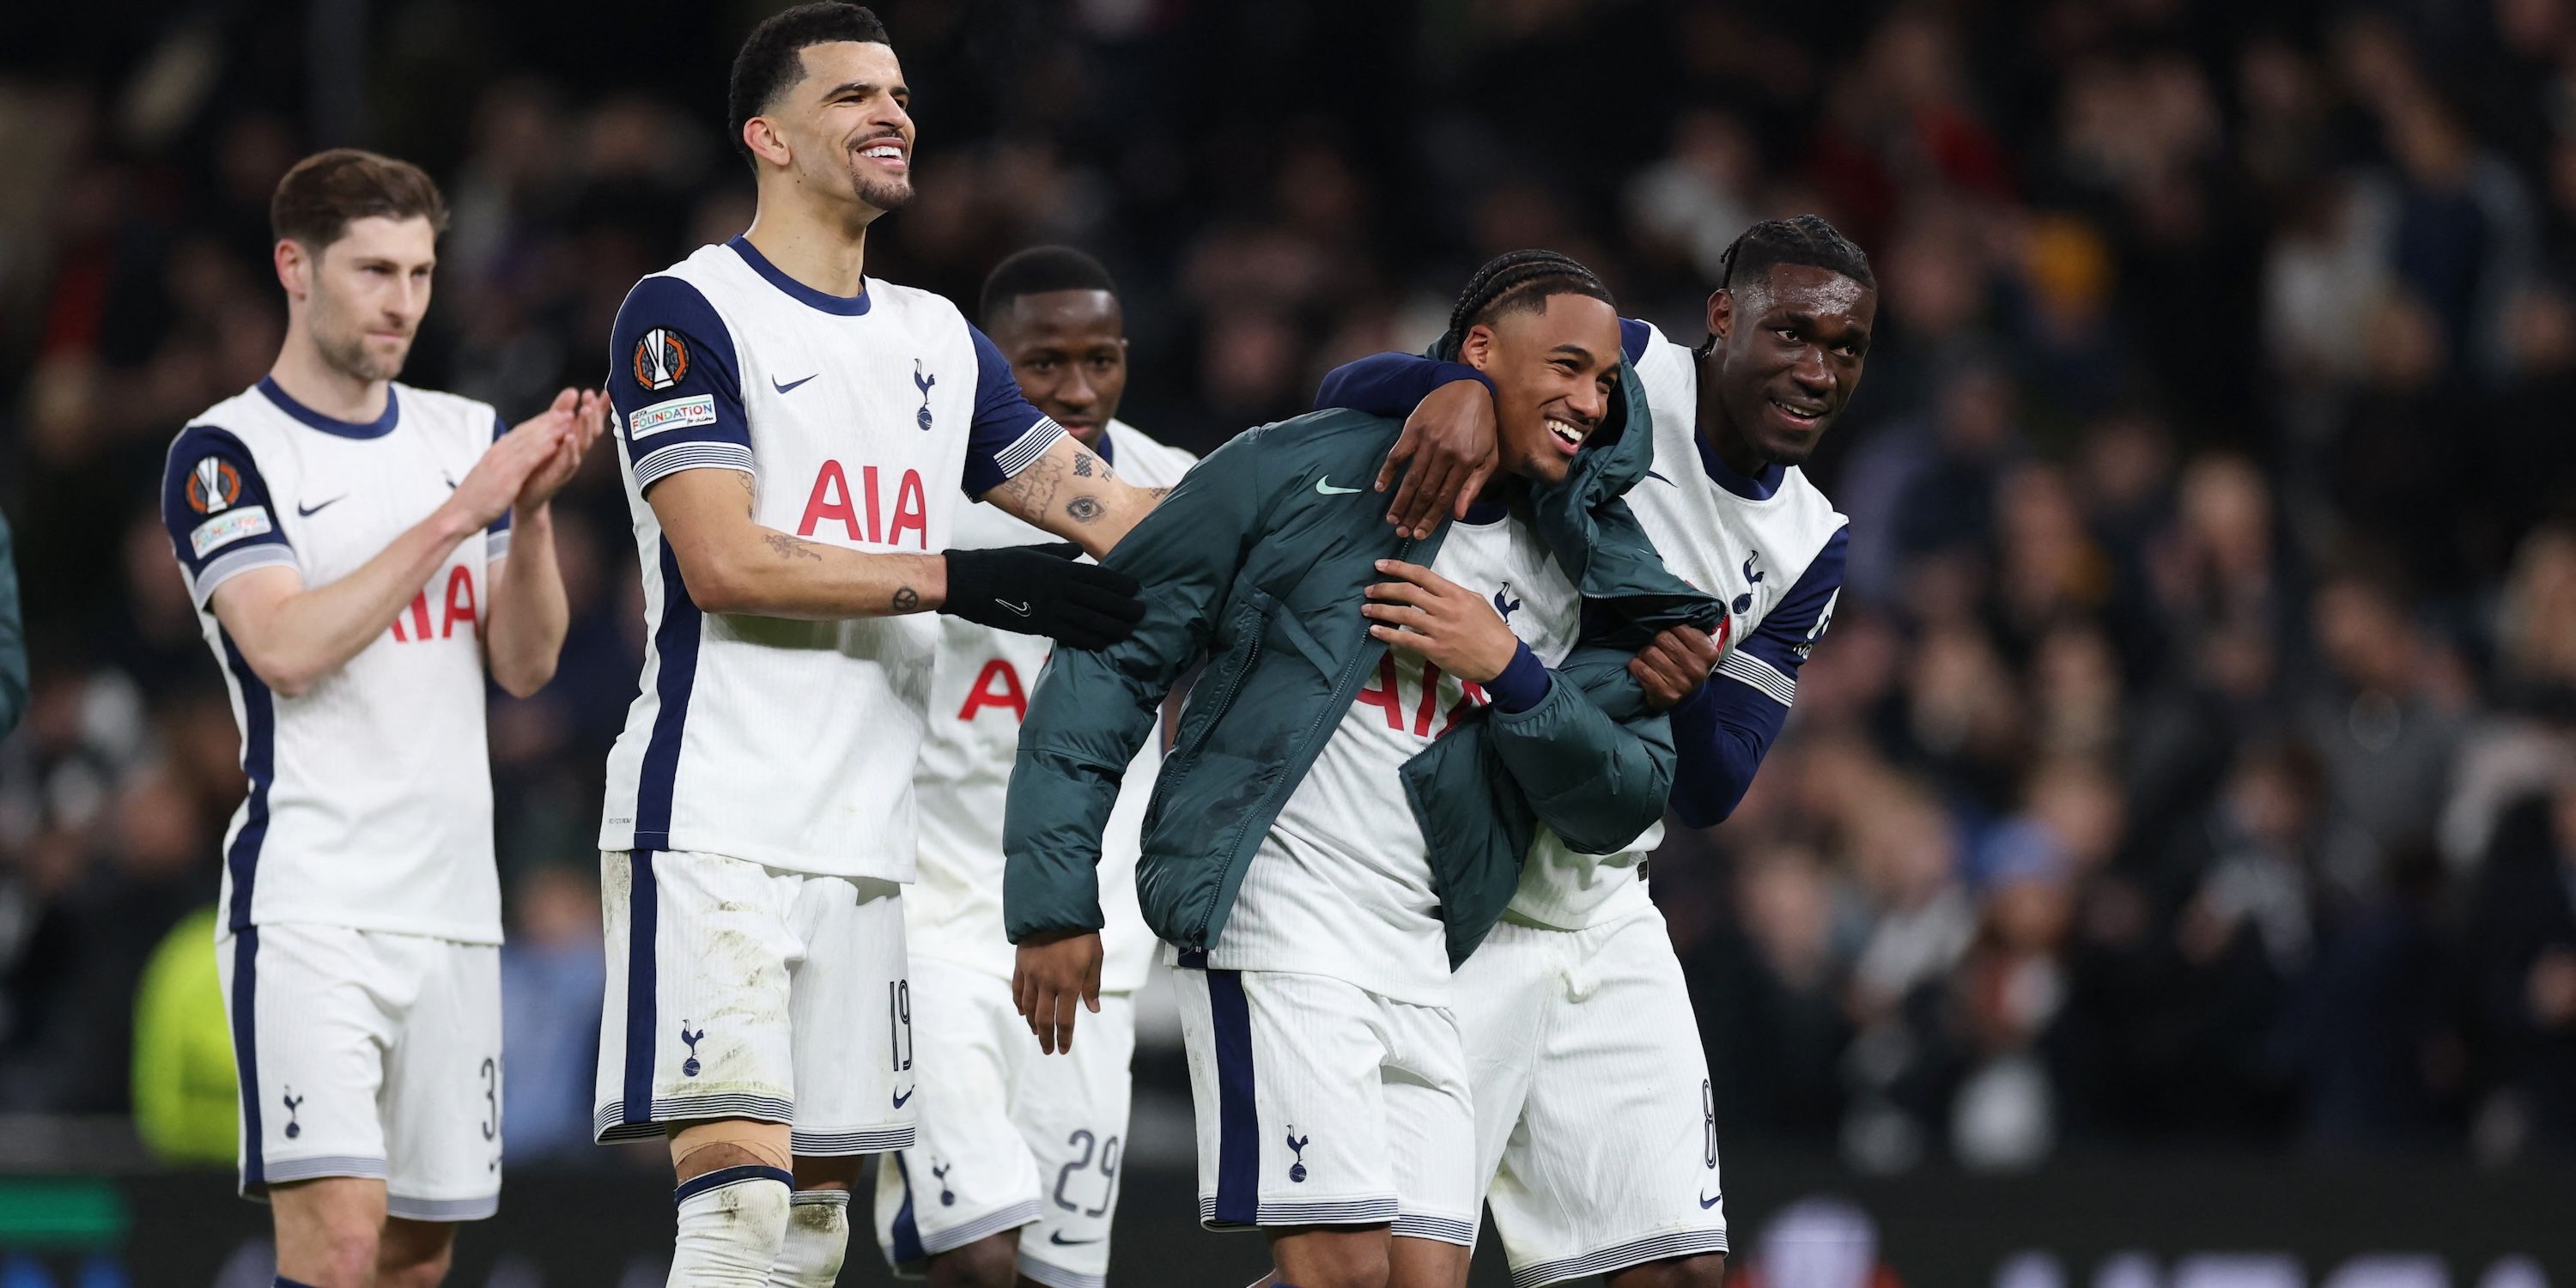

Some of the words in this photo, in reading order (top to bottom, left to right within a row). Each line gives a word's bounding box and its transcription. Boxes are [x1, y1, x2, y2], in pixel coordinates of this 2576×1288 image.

[632, 404, 713, 430] FOUNDATION
[797, 459, 927, 550] AIA
[391, 564, 481, 642] IA
[890, 979, 912, 1072] 19
[480, 1058, 503, 1142] 3
[1702, 1078, 1716, 1169] 8
[1053, 1129, 1118, 1218] 29
